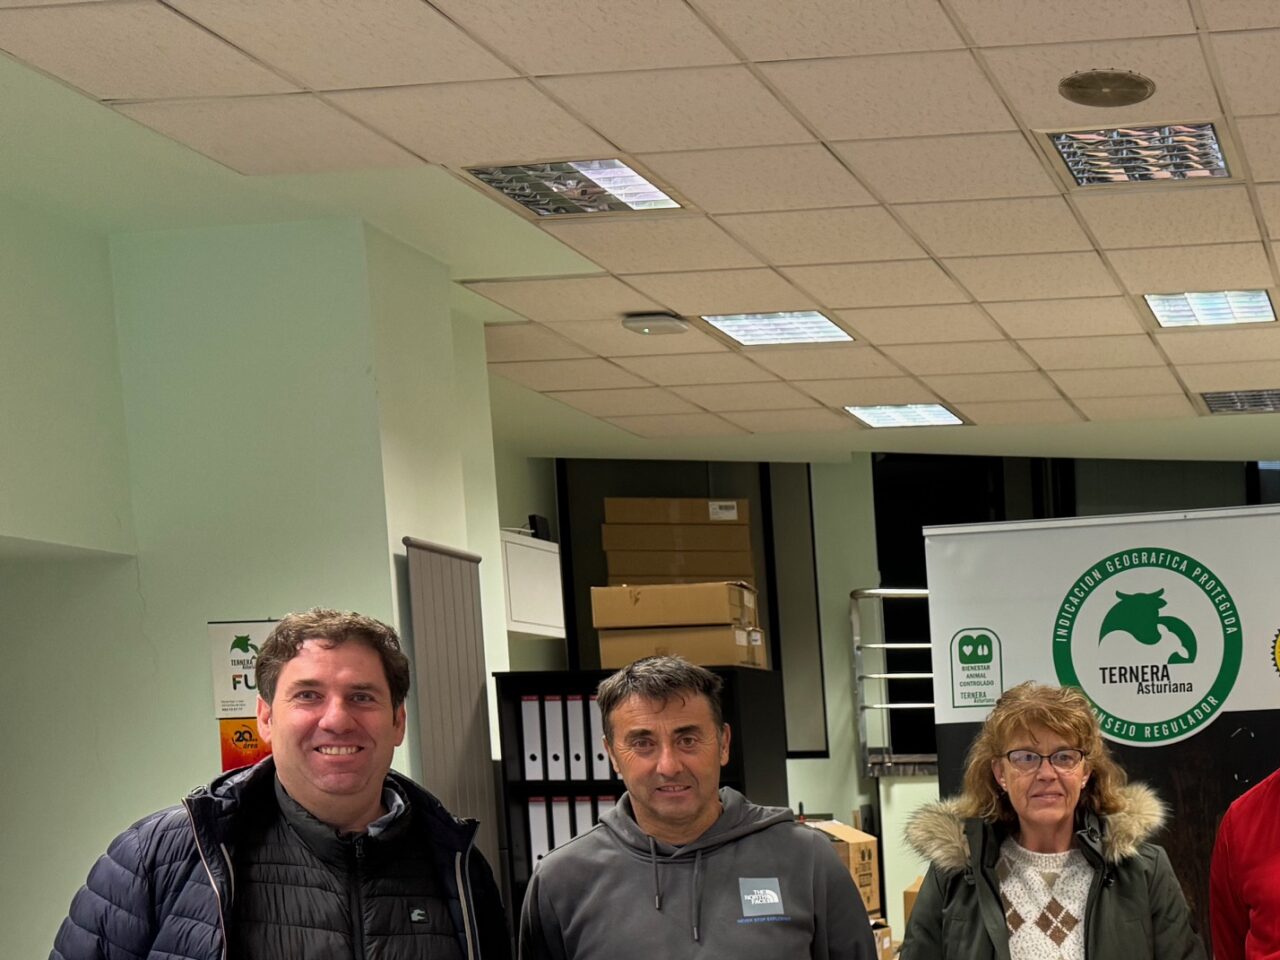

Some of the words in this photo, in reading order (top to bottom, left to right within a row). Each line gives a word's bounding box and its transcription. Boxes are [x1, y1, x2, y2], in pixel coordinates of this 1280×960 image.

[1055, 568, 1103, 642] INDICACION
[1105, 551, 1188, 573] GEOGRAFICA
[1191, 567, 1238, 635] PROTEGIDA
[1099, 664, 1171, 684] TERNERA
[960, 691, 987, 700] TERNERA
[1136, 681, 1193, 695] Asturiana
[1090, 707, 1136, 737] ONSEJO
[1144, 695, 1219, 739] REGULADOR
